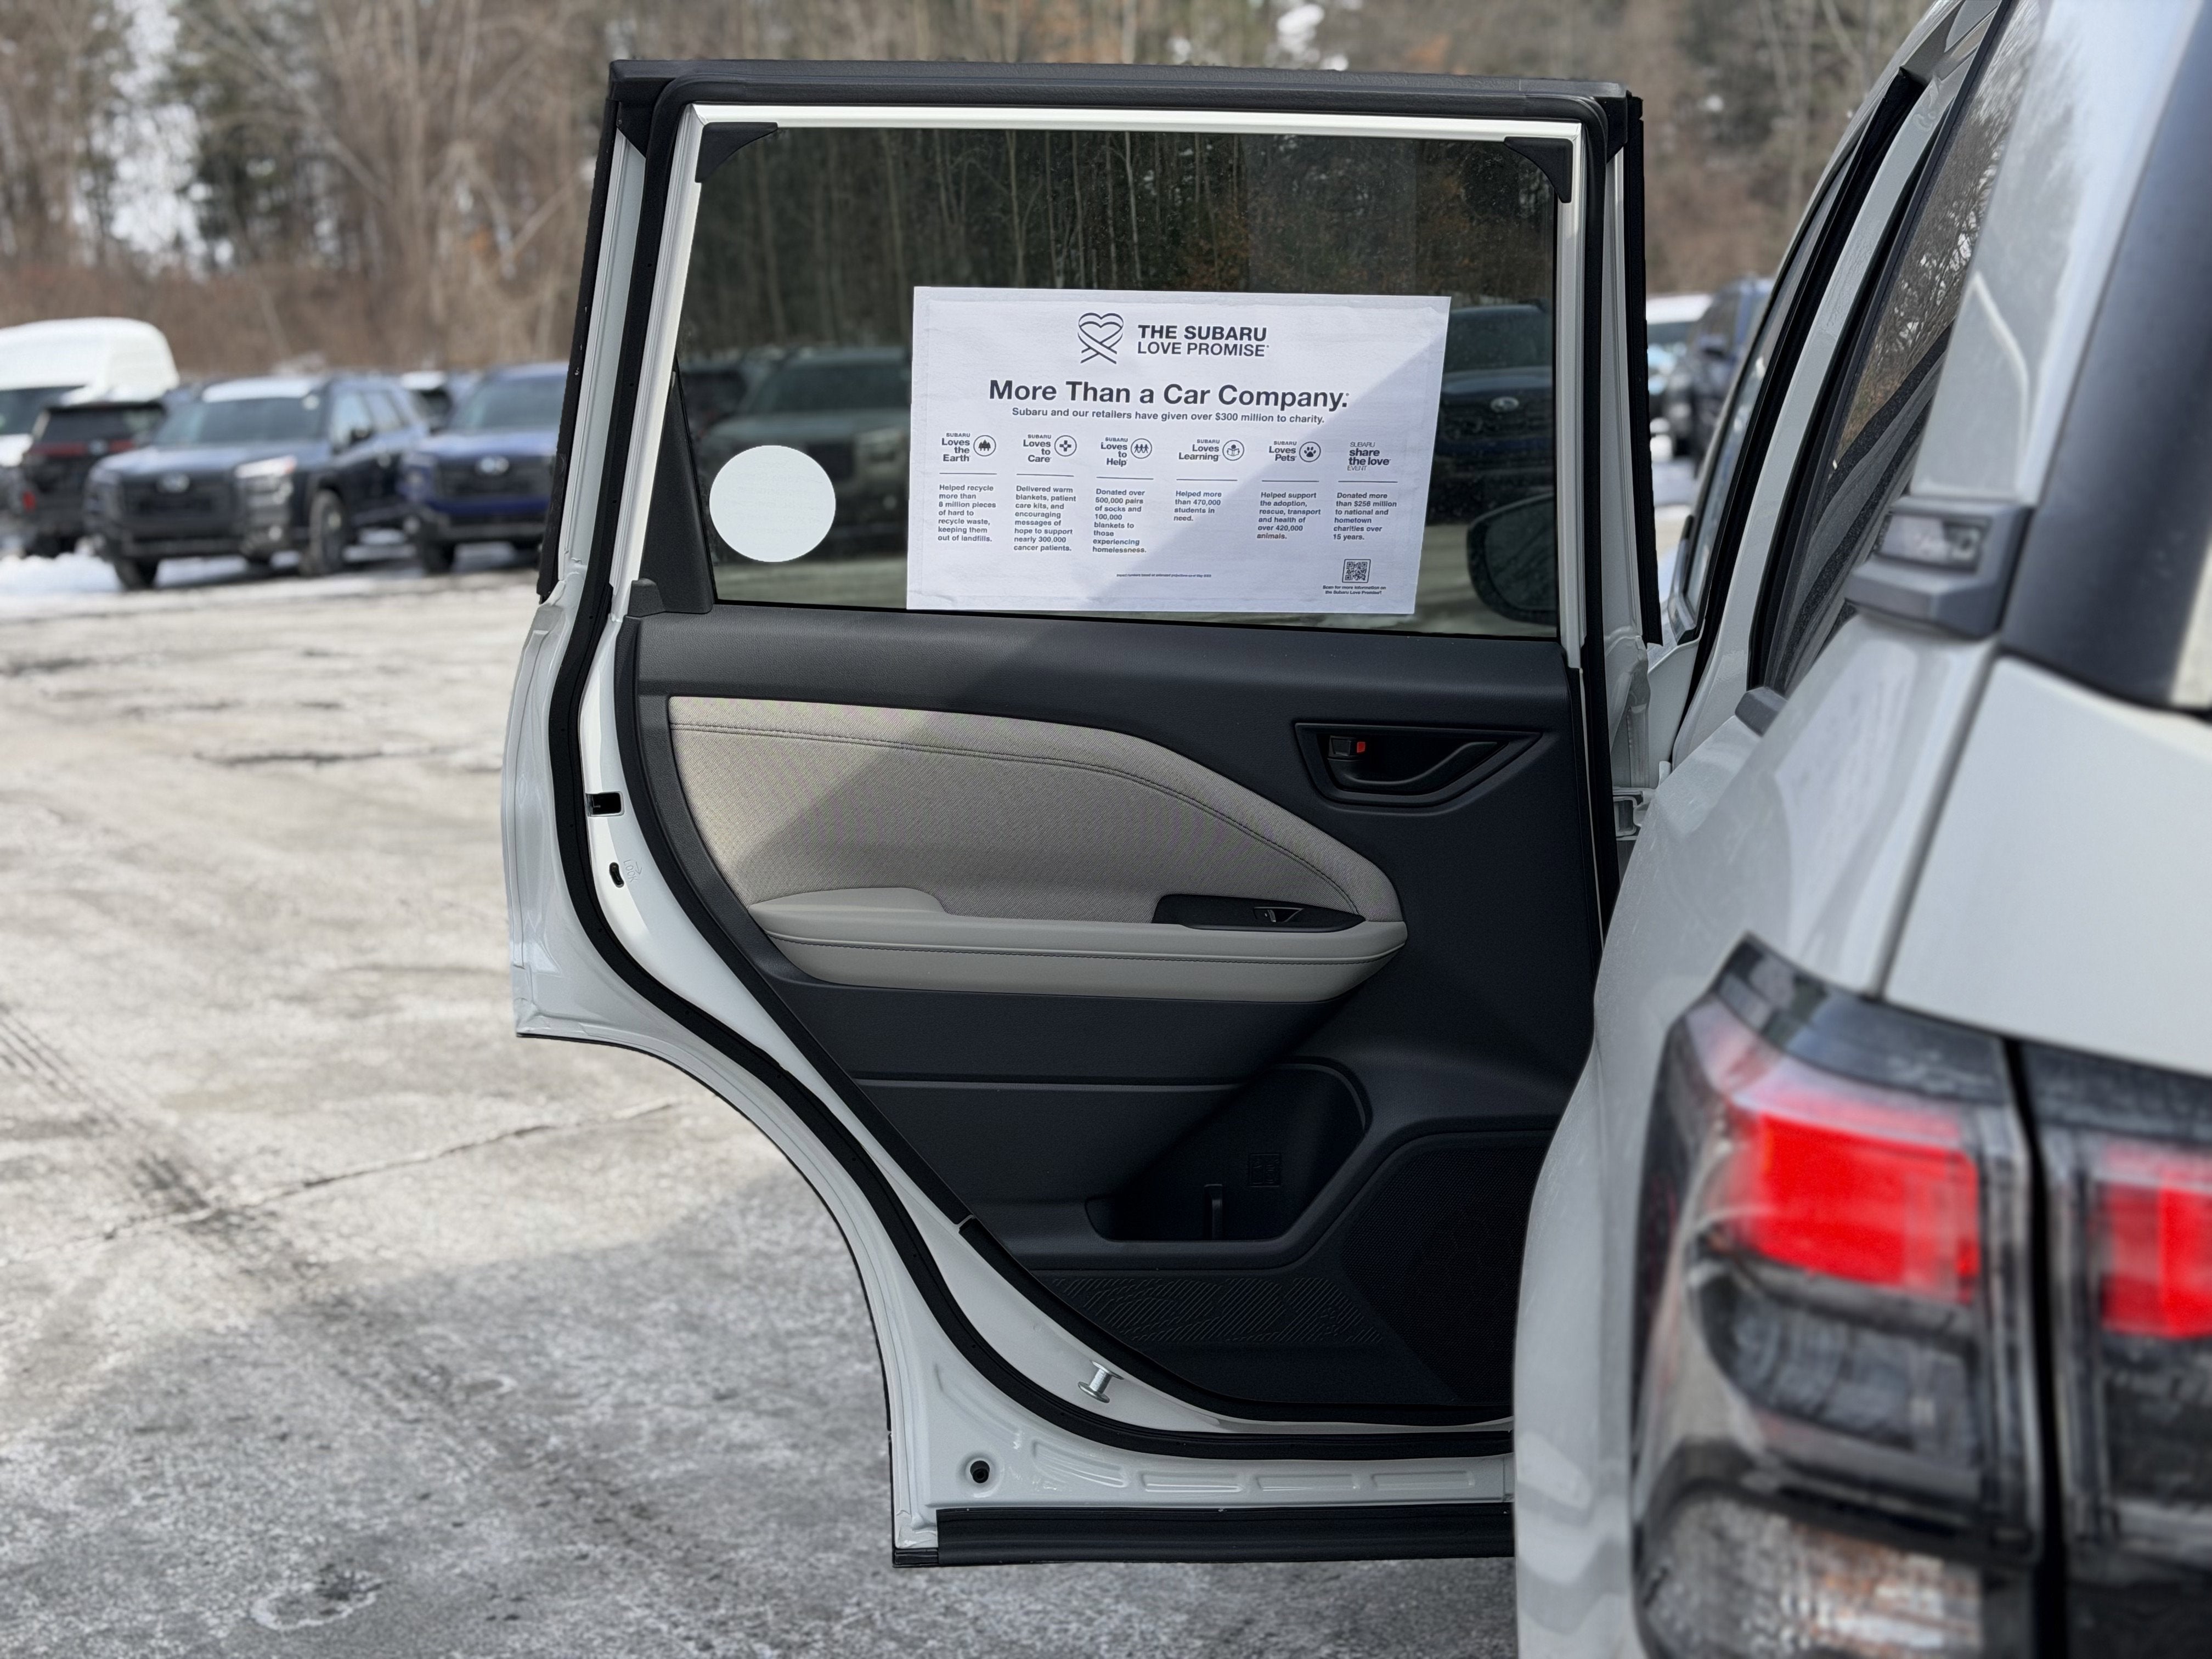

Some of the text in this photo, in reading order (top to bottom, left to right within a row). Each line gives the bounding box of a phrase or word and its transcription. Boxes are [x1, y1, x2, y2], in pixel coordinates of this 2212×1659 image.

[1137, 324, 1267, 342] THE SUBARU
[1137, 341, 1182, 354] LOVE
[990, 380, 1057, 400] More
[1065, 381, 1130, 403] Than
[1139, 388, 1154, 404] a
[1164, 383, 1211, 404] Car
[1012, 407, 1048, 416] Subaru
[1051, 408, 1069, 416] and
[1092, 410, 1132, 419] retailers
[1135, 411, 1159, 420] have
[1161, 411, 1188, 422] given
[1215, 412, 1238, 421] $300
[1241, 413, 1274, 422] million
[1277, 414, 1286, 422] to
[1289, 414, 1324, 425] charity.
[941, 437, 970, 446] Loves
[1023, 439, 1051, 448] Loves
[1101, 442, 1128, 450] Loves
[1192, 444, 1220, 452] Loves
[1268, 445, 1296, 454] Loves
[1349, 448, 1380, 458] share
[1348, 456, 1366, 465] the
[1176, 490, 1201, 498] Helped
[1261, 492, 1286, 500] Helped
[938, 526, 967, 534] keeping
[1014, 527, 1033, 535] hope
[623, 859, 637, 882] LOCK
